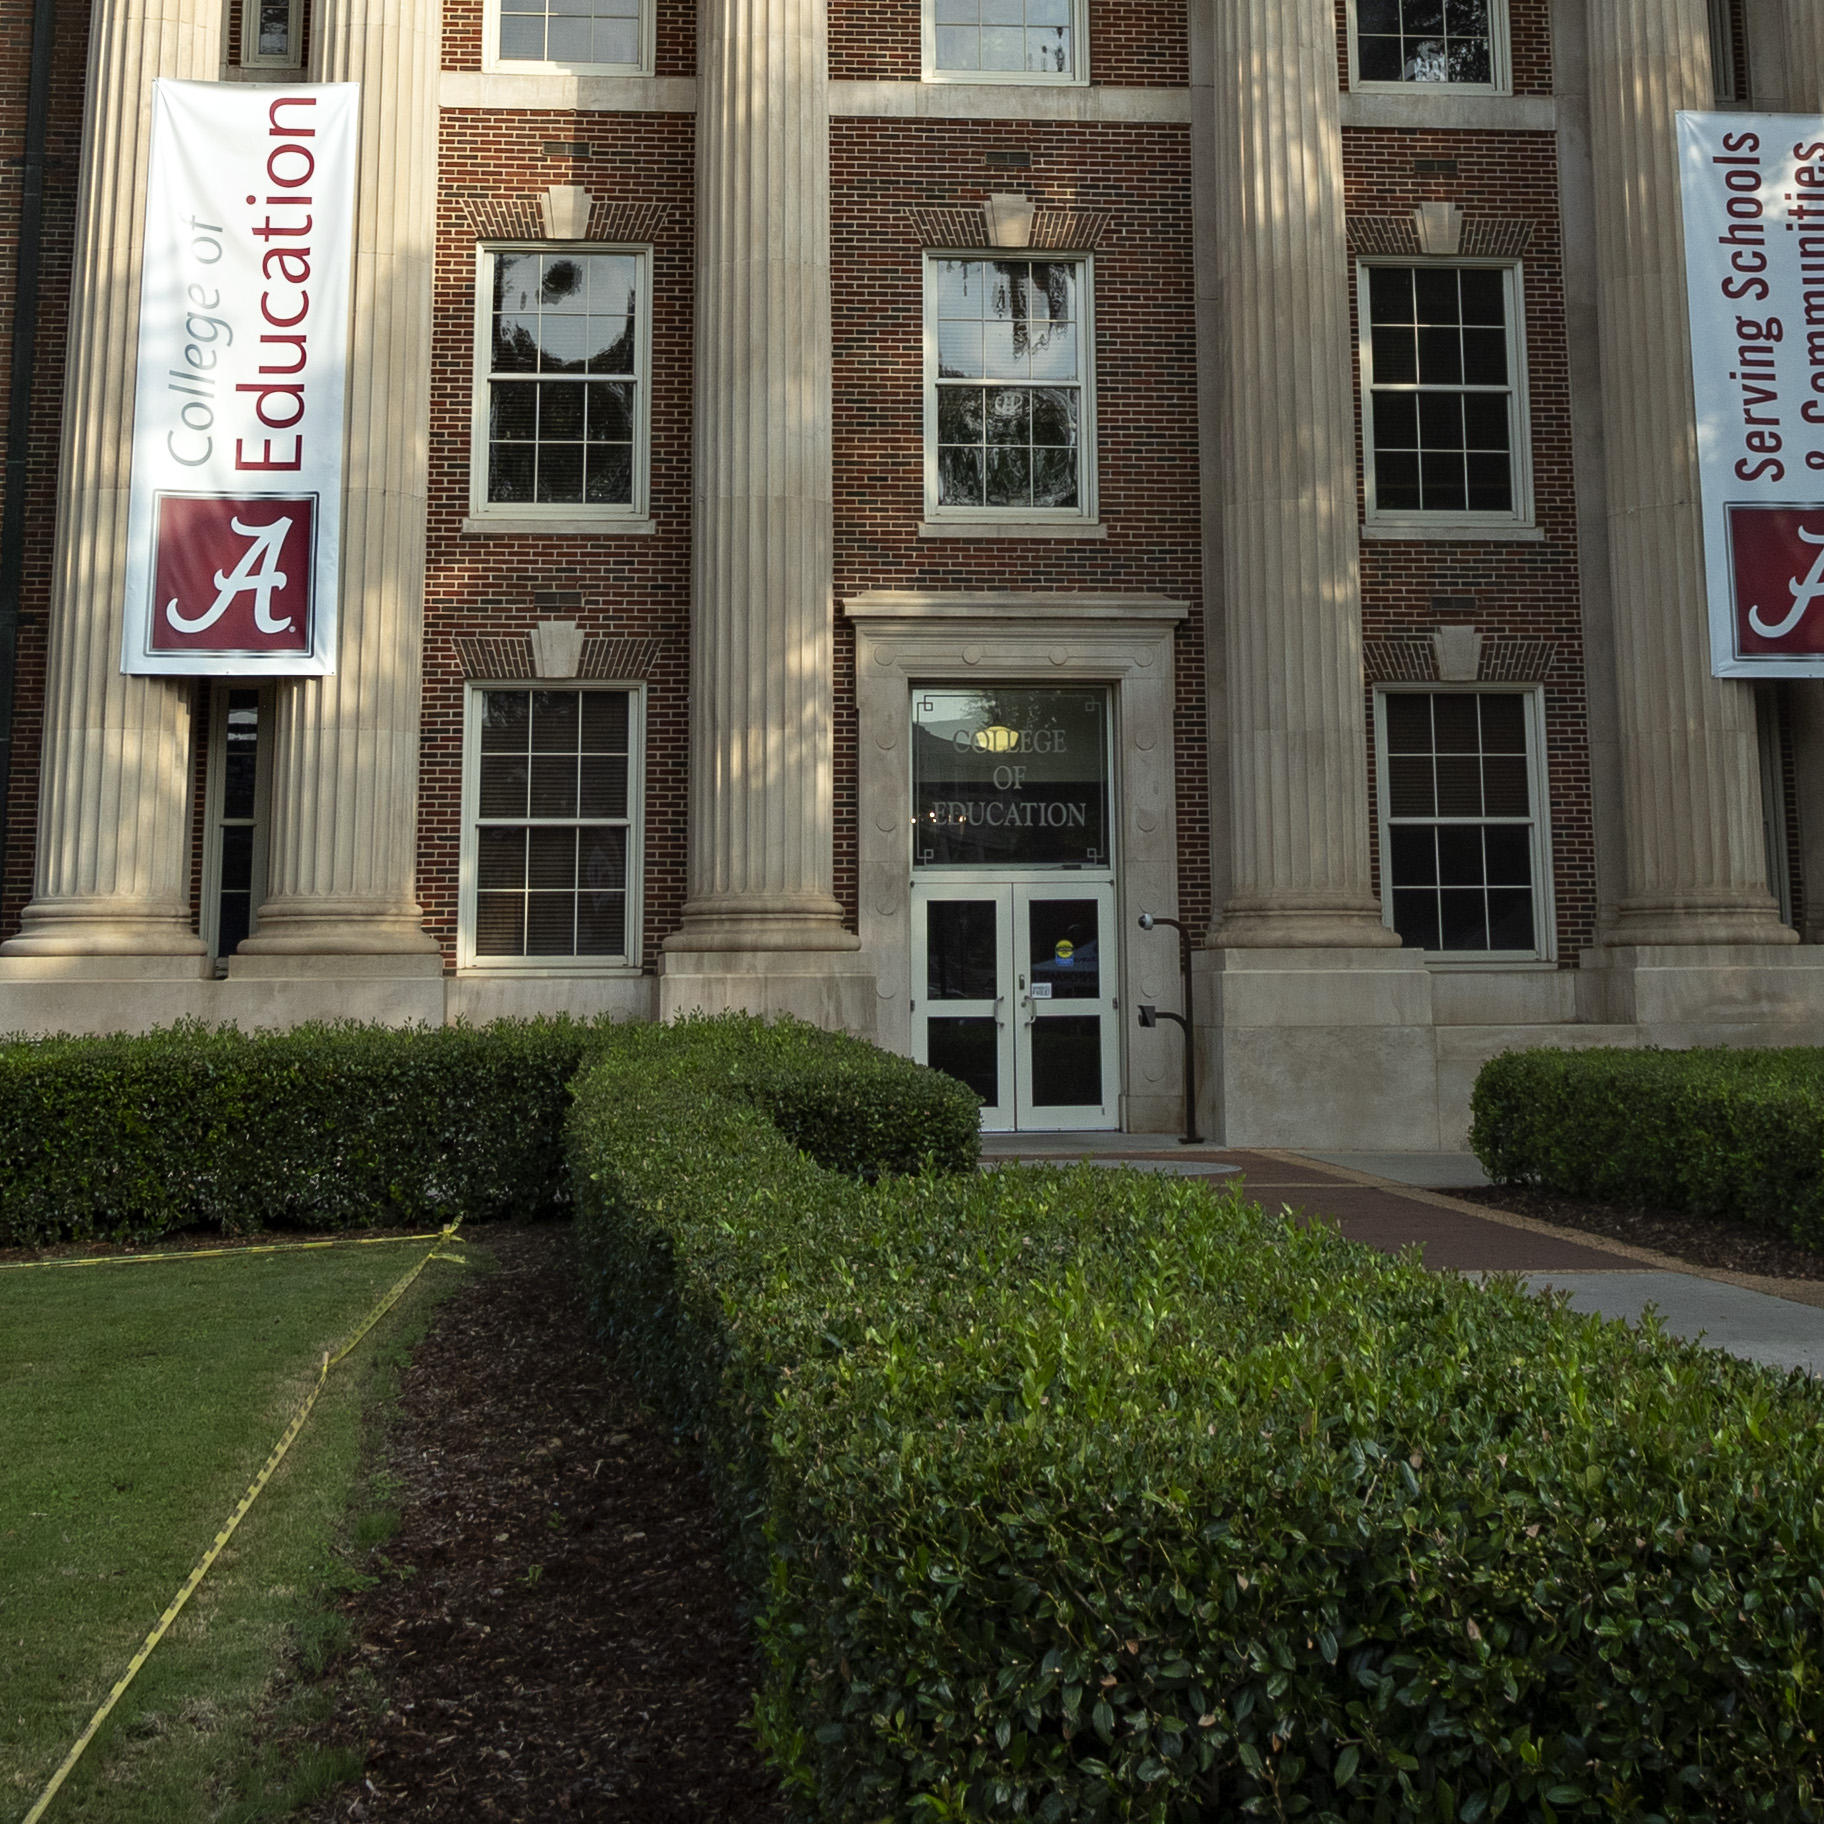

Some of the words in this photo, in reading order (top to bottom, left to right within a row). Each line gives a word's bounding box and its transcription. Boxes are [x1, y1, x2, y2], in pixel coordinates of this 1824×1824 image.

[178, 213, 224, 264] of
[1712, 131, 1770, 301] Schools
[235, 97, 317, 472] Education
[166, 286, 233, 467] College
[1729, 314, 1784, 483] Serving
[952, 729, 1068, 754] COLLEGE
[992, 765, 1027, 790] OF
[932, 801, 1087, 827] EDUCATION
